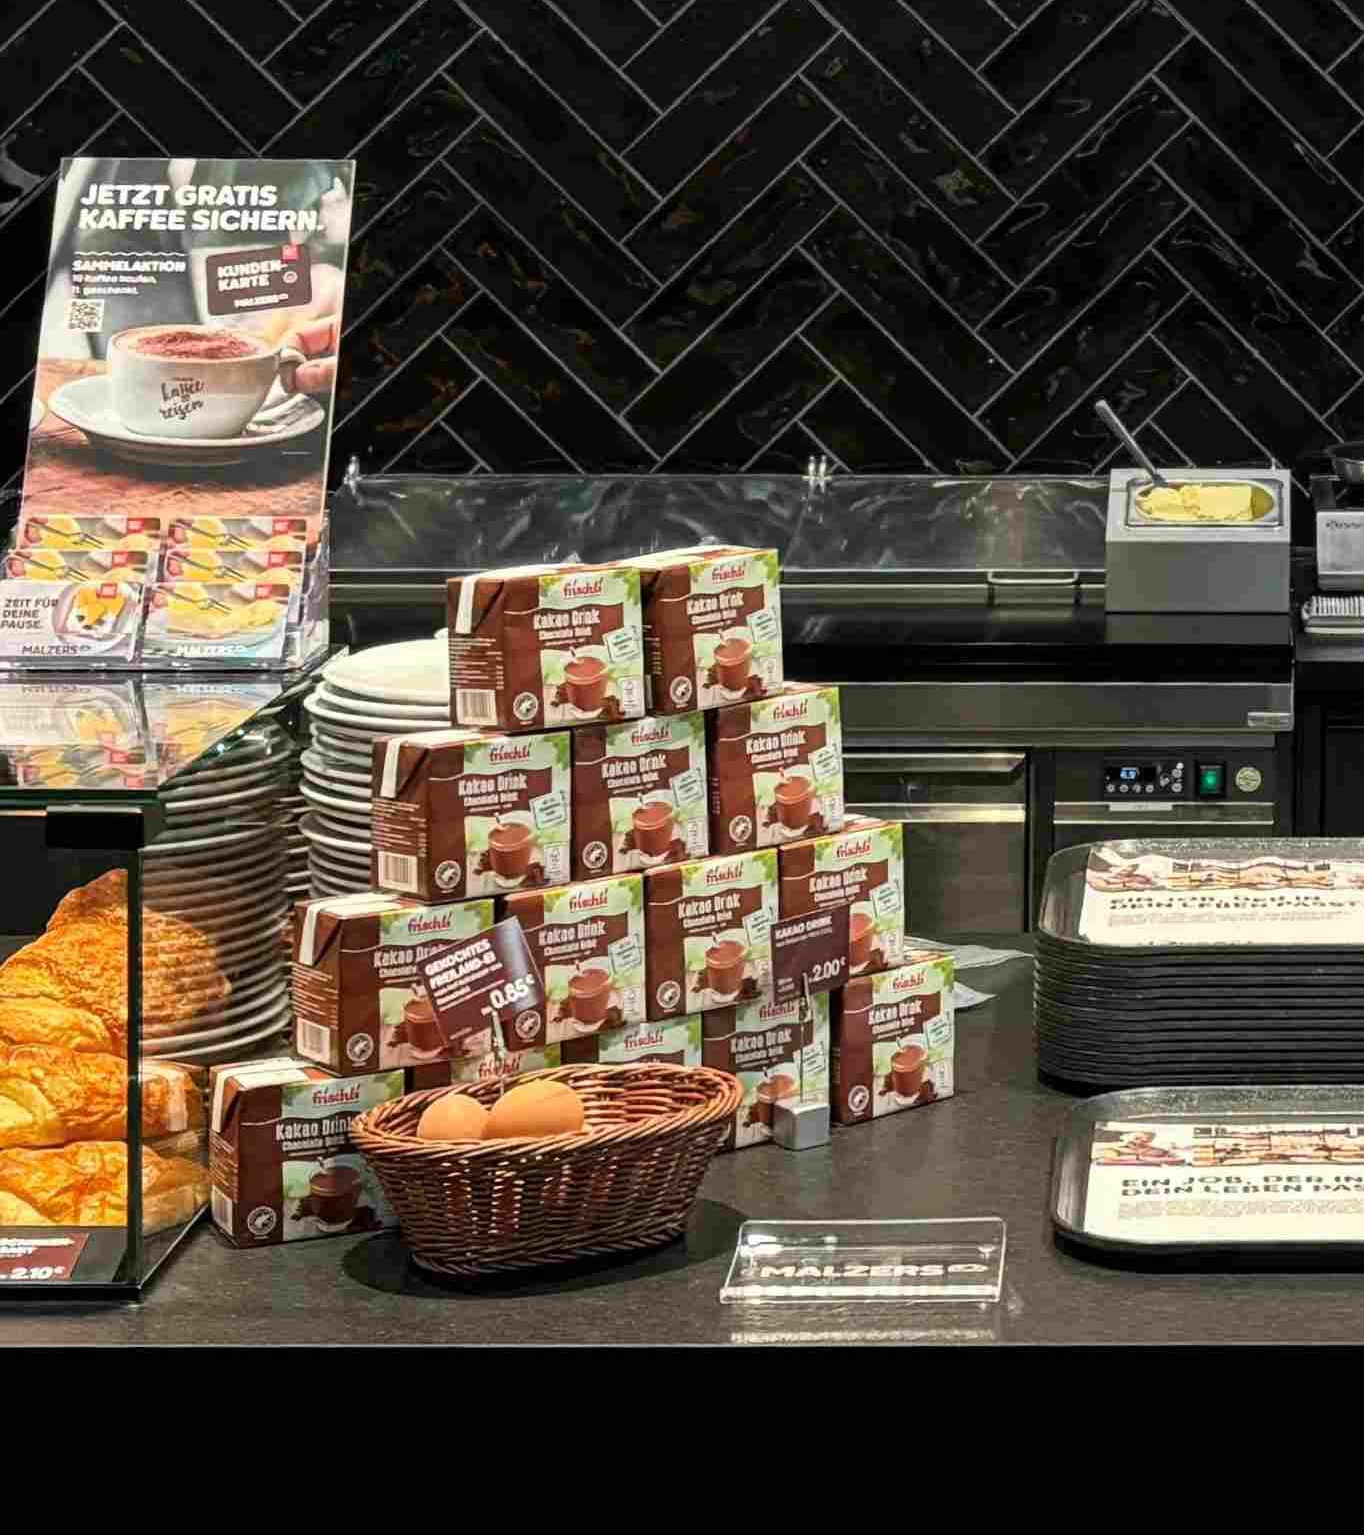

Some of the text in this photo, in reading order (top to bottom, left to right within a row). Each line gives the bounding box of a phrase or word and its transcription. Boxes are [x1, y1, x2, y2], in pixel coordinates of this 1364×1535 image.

[80, 184, 278, 207] JETZT GRATIS
[78, 208, 325, 231] KAFFEE SICHERN.
[533, 609, 568, 630] Kakao
[758, 1264, 946, 1279] MALZERS
